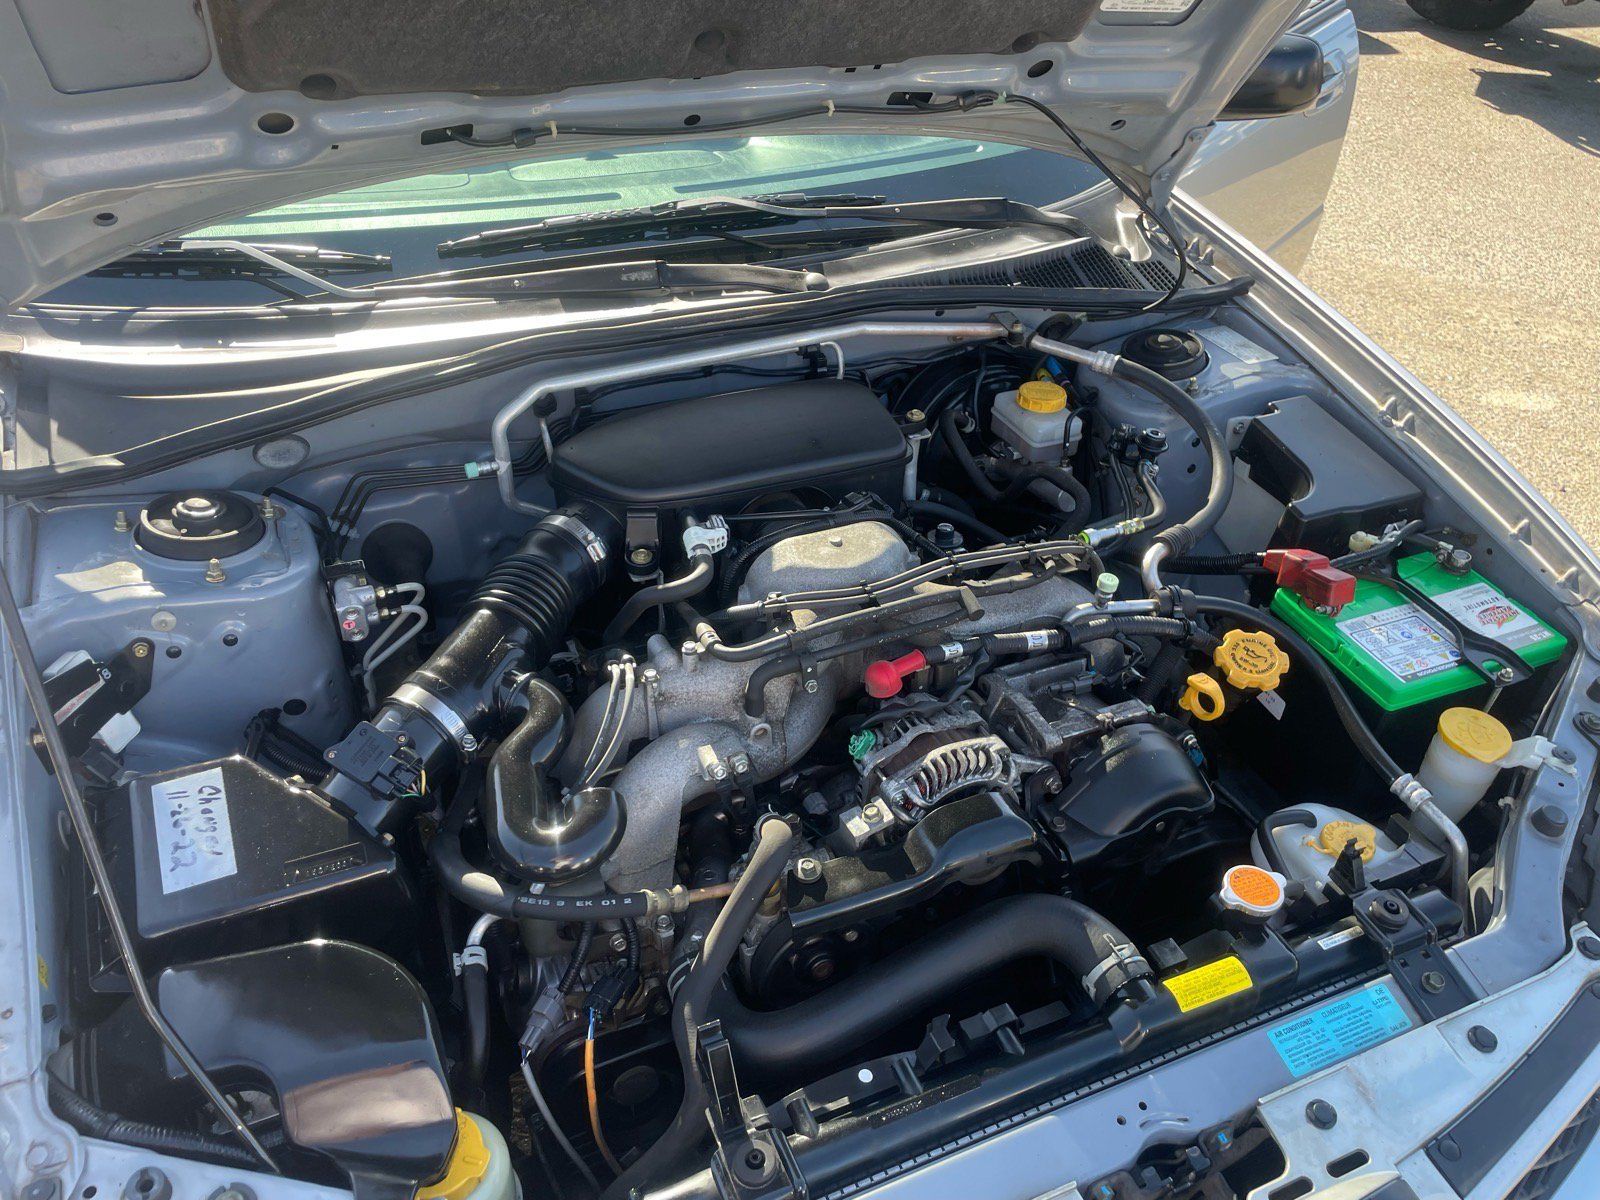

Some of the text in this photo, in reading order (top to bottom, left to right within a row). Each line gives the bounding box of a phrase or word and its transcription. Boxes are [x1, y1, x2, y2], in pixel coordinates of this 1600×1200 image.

[1463, 596, 1500, 611] AUTOMOTIVE
[1479, 605, 1514, 620] BATTERIES
[1481, 609, 1520, 626] INTERSTATE
[1282, 1017, 1314, 1036] CONDITIONER
